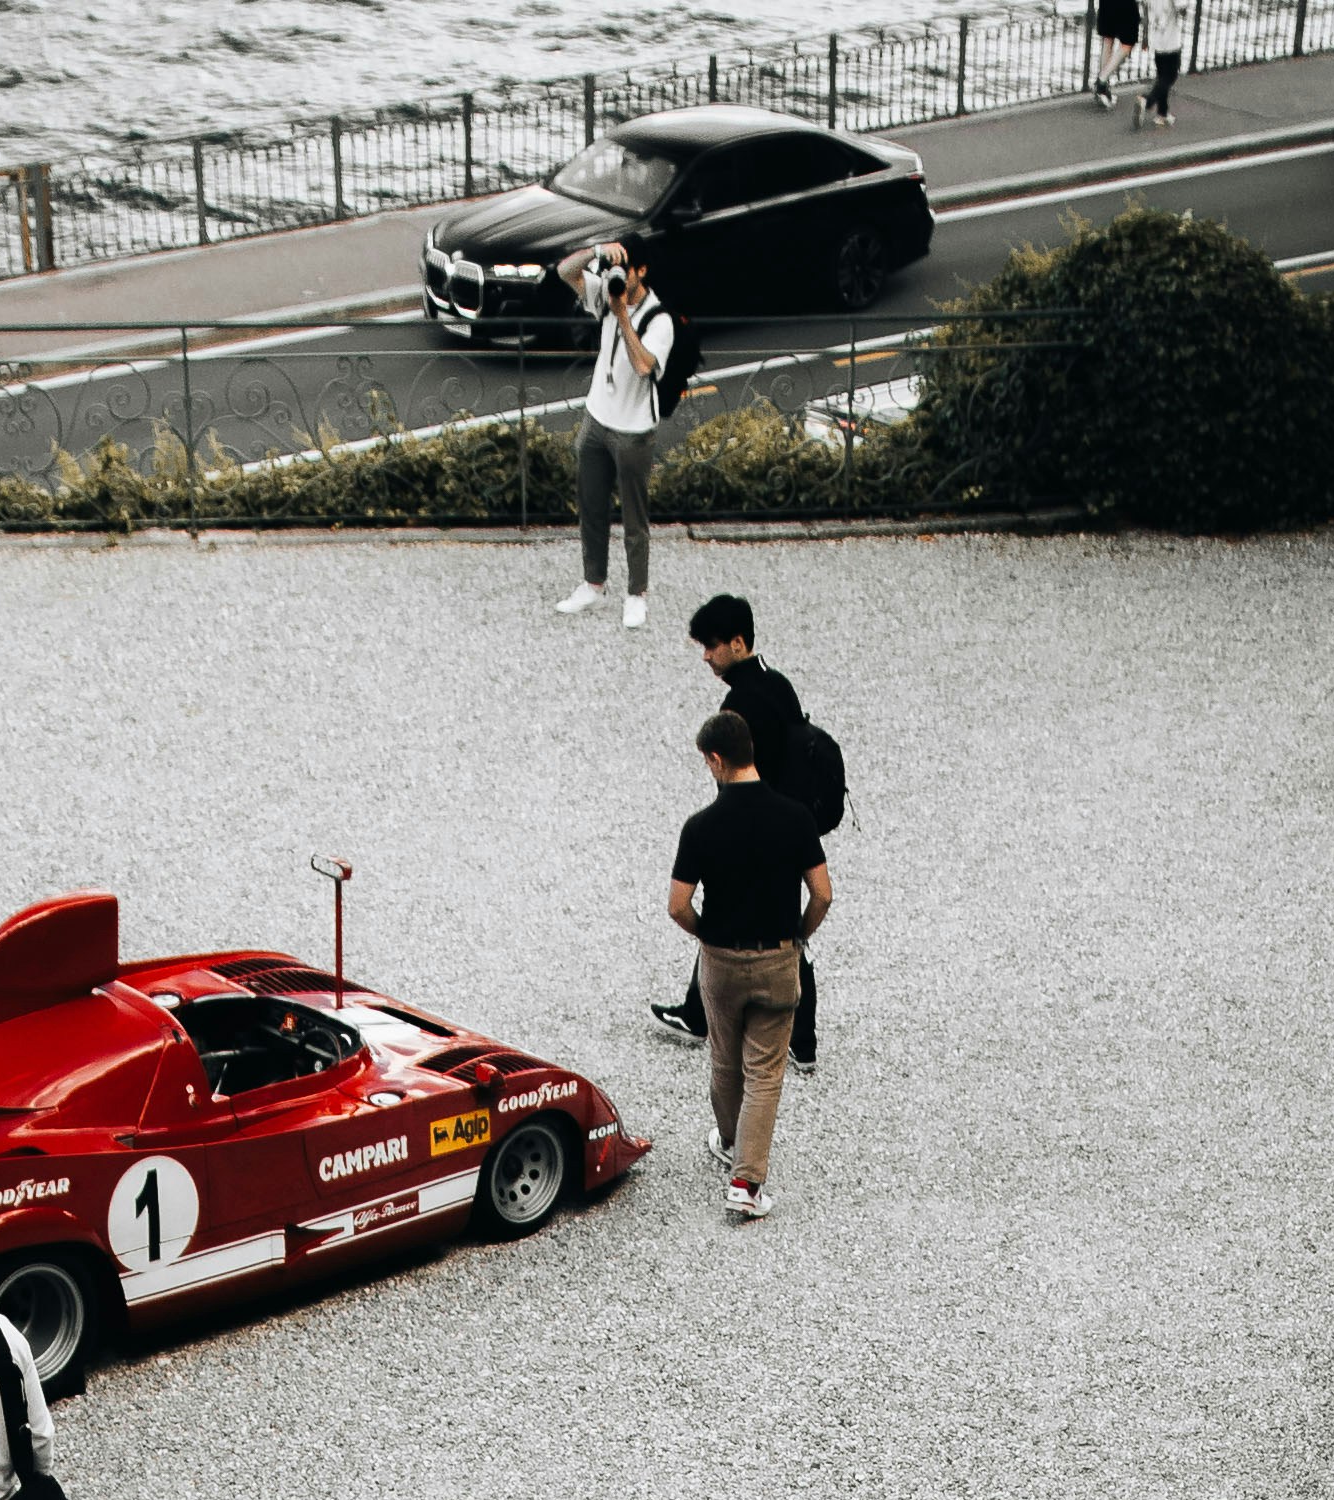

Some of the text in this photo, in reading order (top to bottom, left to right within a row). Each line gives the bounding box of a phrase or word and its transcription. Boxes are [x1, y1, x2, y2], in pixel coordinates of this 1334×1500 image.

[498, 1080, 578, 1113] GOODYEAR
[452, 1112, 489, 1143] Agip
[588, 1122, 618, 1141] KONI
[319, 1135, 408, 1182] CAMPARI
[135, 1168, 161, 1262] 1
[354, 1208, 381, 1230] Alfa
